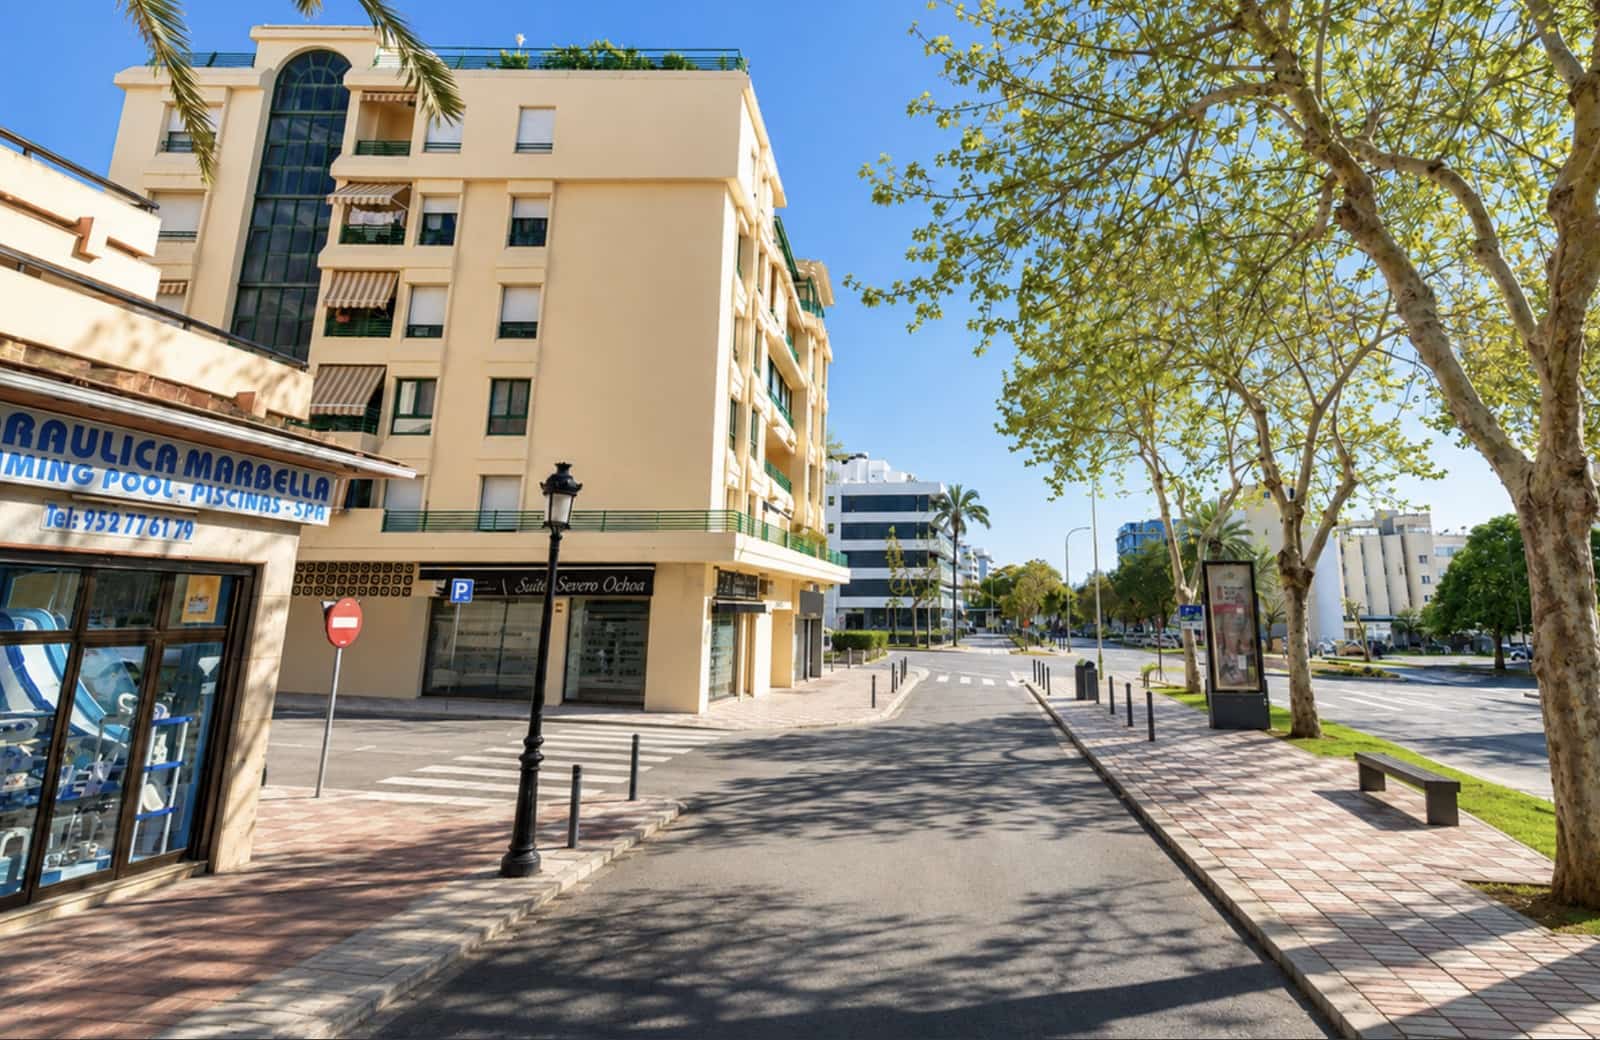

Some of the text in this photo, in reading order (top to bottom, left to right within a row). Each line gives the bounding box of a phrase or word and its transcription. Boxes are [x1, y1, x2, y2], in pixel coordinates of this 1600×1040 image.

[0, 412, 331, 501] RAULICA MARBELLA
[0, 450, 95, 485] MING
[294, 501, 326, 521] SPA
[47, 503, 79, 529] Tel:
[84, 509, 121, 534] 952
[124, 512, 148, 536] 77
[173, 519, 194, 541] 79
[454, 582, 469, 600] P
[555, 575, 599, 593] Severo
[602, 575, 646, 593] Ochoa
